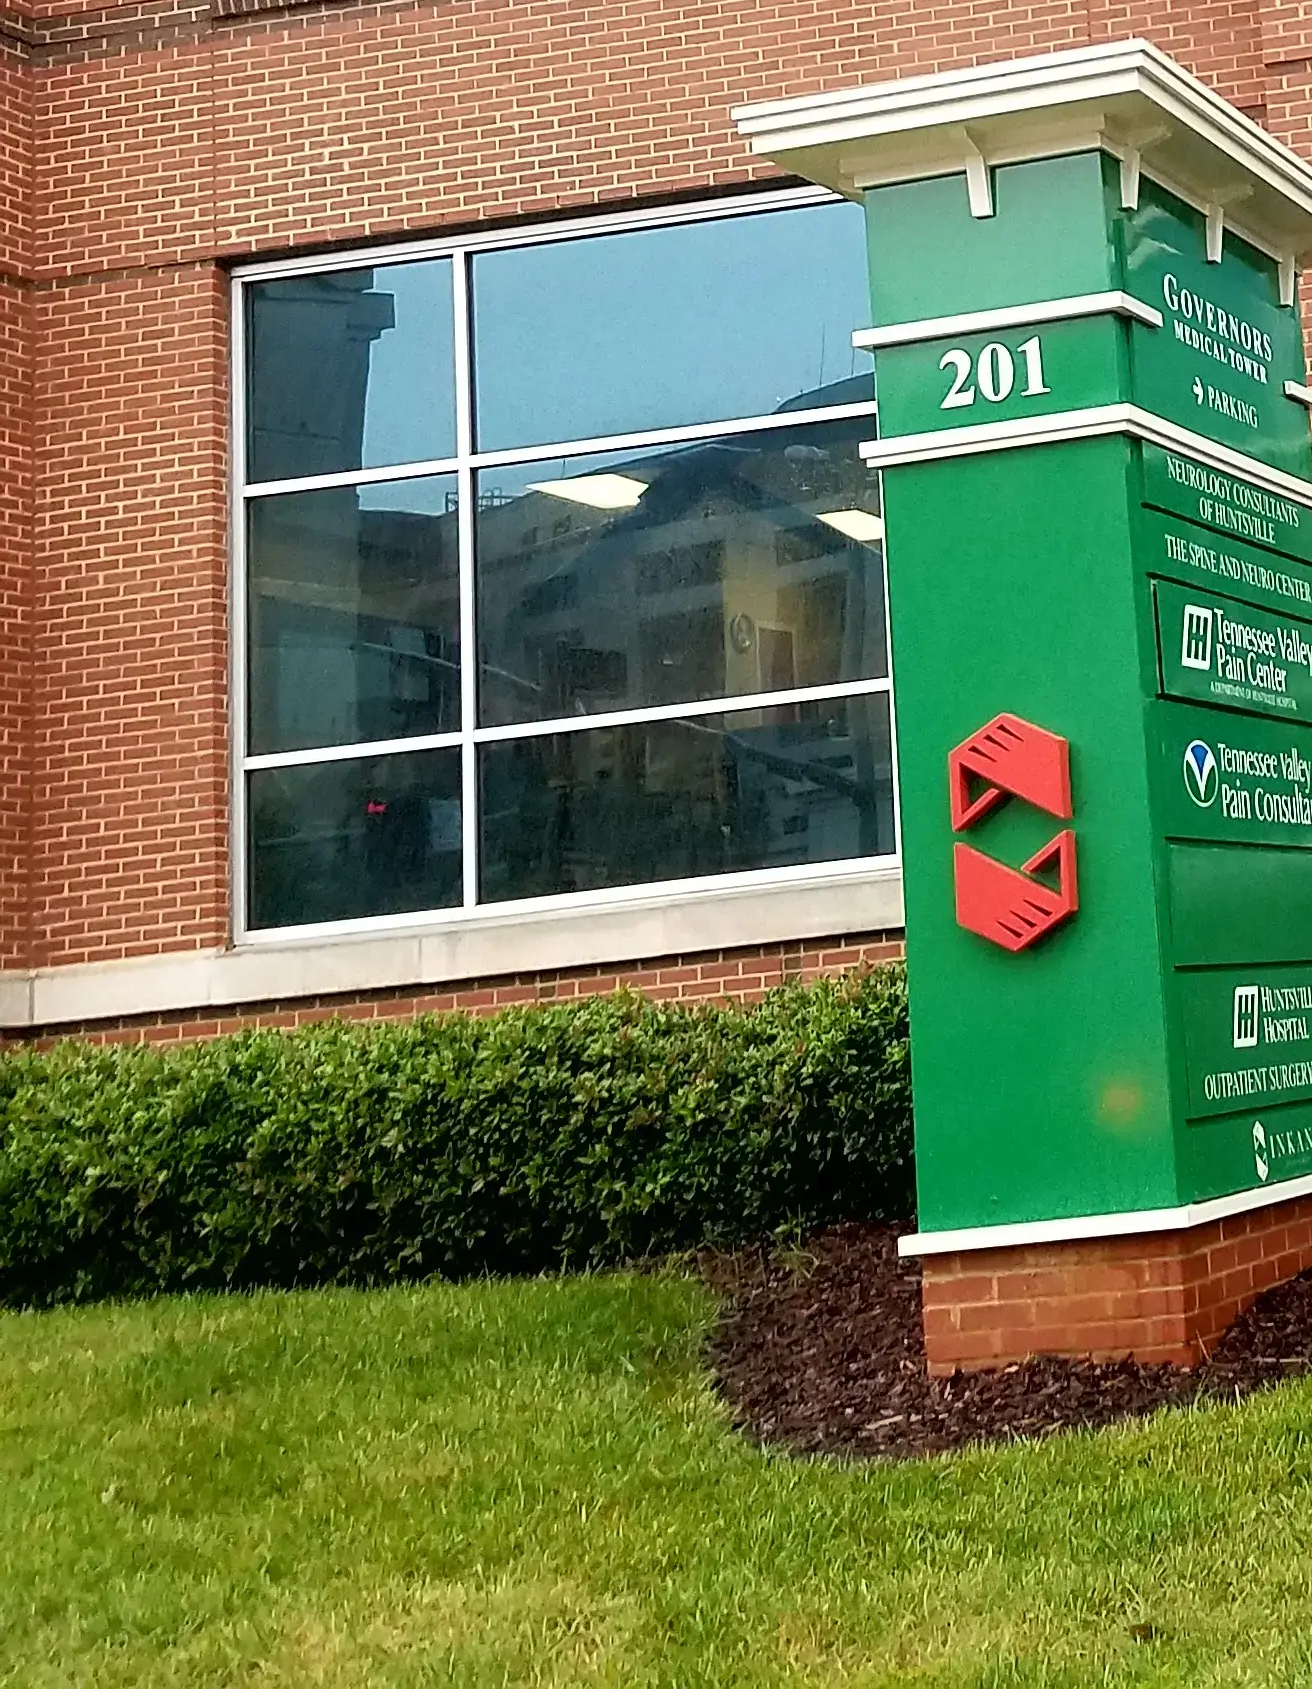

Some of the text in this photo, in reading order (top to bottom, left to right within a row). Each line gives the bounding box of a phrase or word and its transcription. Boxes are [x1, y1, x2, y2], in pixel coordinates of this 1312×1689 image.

[1164, 273, 1272, 361] GOVERNORS
[939, 336, 1051, 410] 201
[1174, 319, 1267, 384] MEDICAL TOWER
[1208, 385, 1258, 428] PARKING
[1167, 457, 1299, 527] NEUROLOGY CONSULTANTS
[1200, 497, 1275, 543] OF HUNTSVILLE
[1165, 534, 1311, 602] THE SPINE AND NEURO CENTER
[1214, 608, 1276, 657] Tennessee
[1216, 644, 1286, 692] Pain Center
[1218, 743, 1311, 793] Tennessee Valley
[1221, 779, 1251, 820] Pain
[1264, 1017, 1309, 1043] HOSPITAL
[1205, 1068, 1268, 1100] OUTPATIENT
